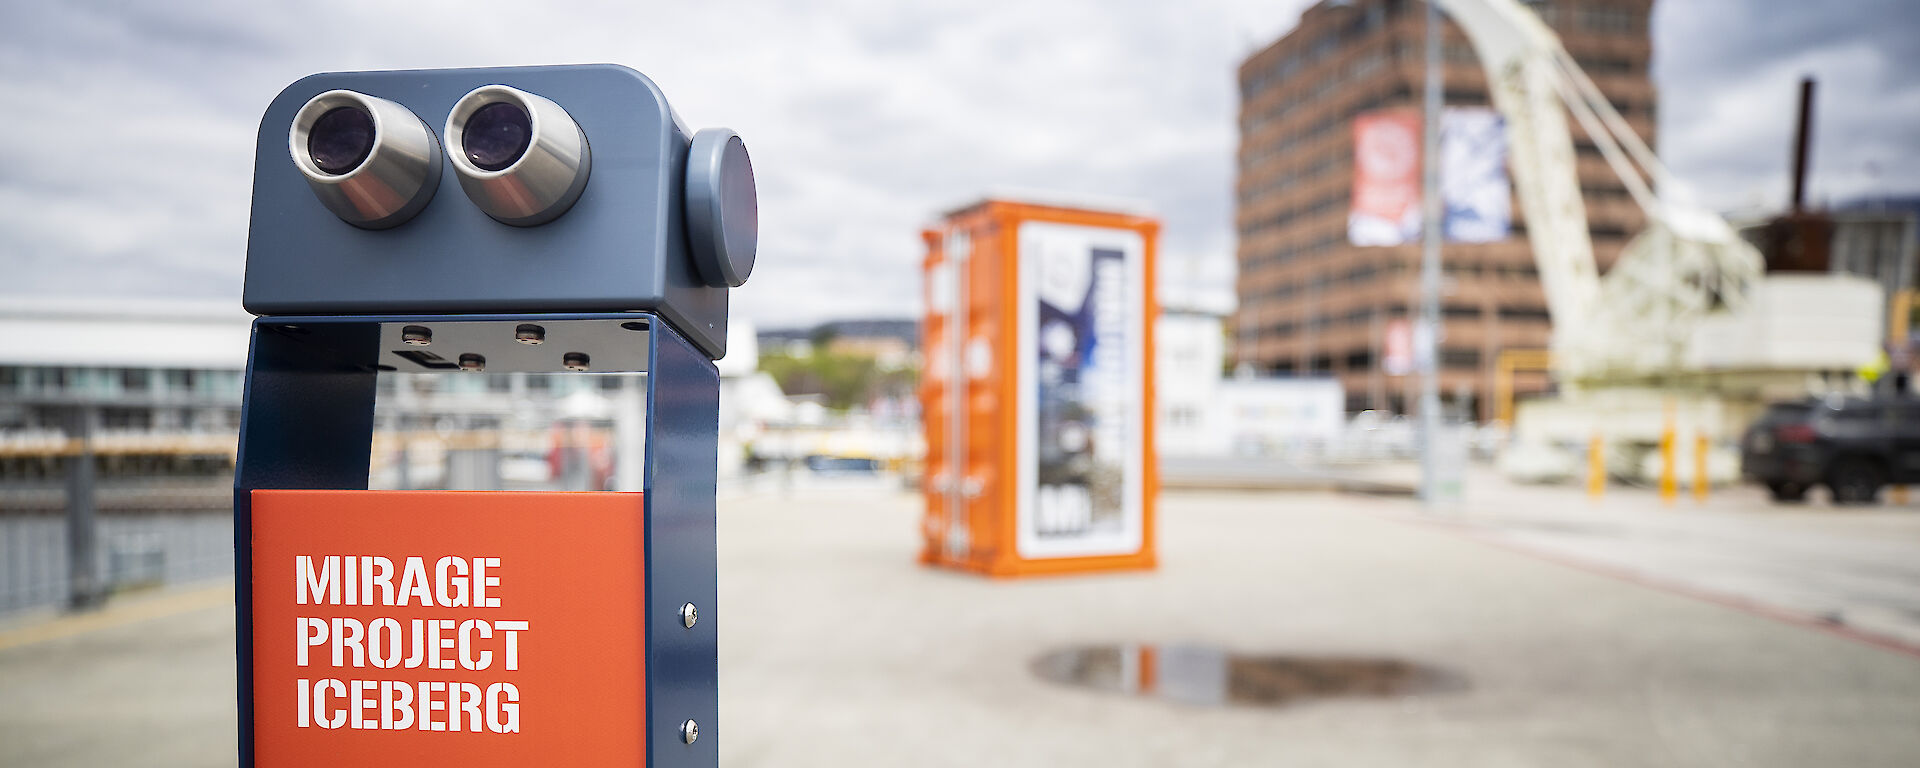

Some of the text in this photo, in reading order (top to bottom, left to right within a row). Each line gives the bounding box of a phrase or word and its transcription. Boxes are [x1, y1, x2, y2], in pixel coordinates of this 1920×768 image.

[296, 556, 501, 607] MIRAGE
[297, 618, 529, 670] PROJECT
[298, 679, 520, 733] ICEBERG
